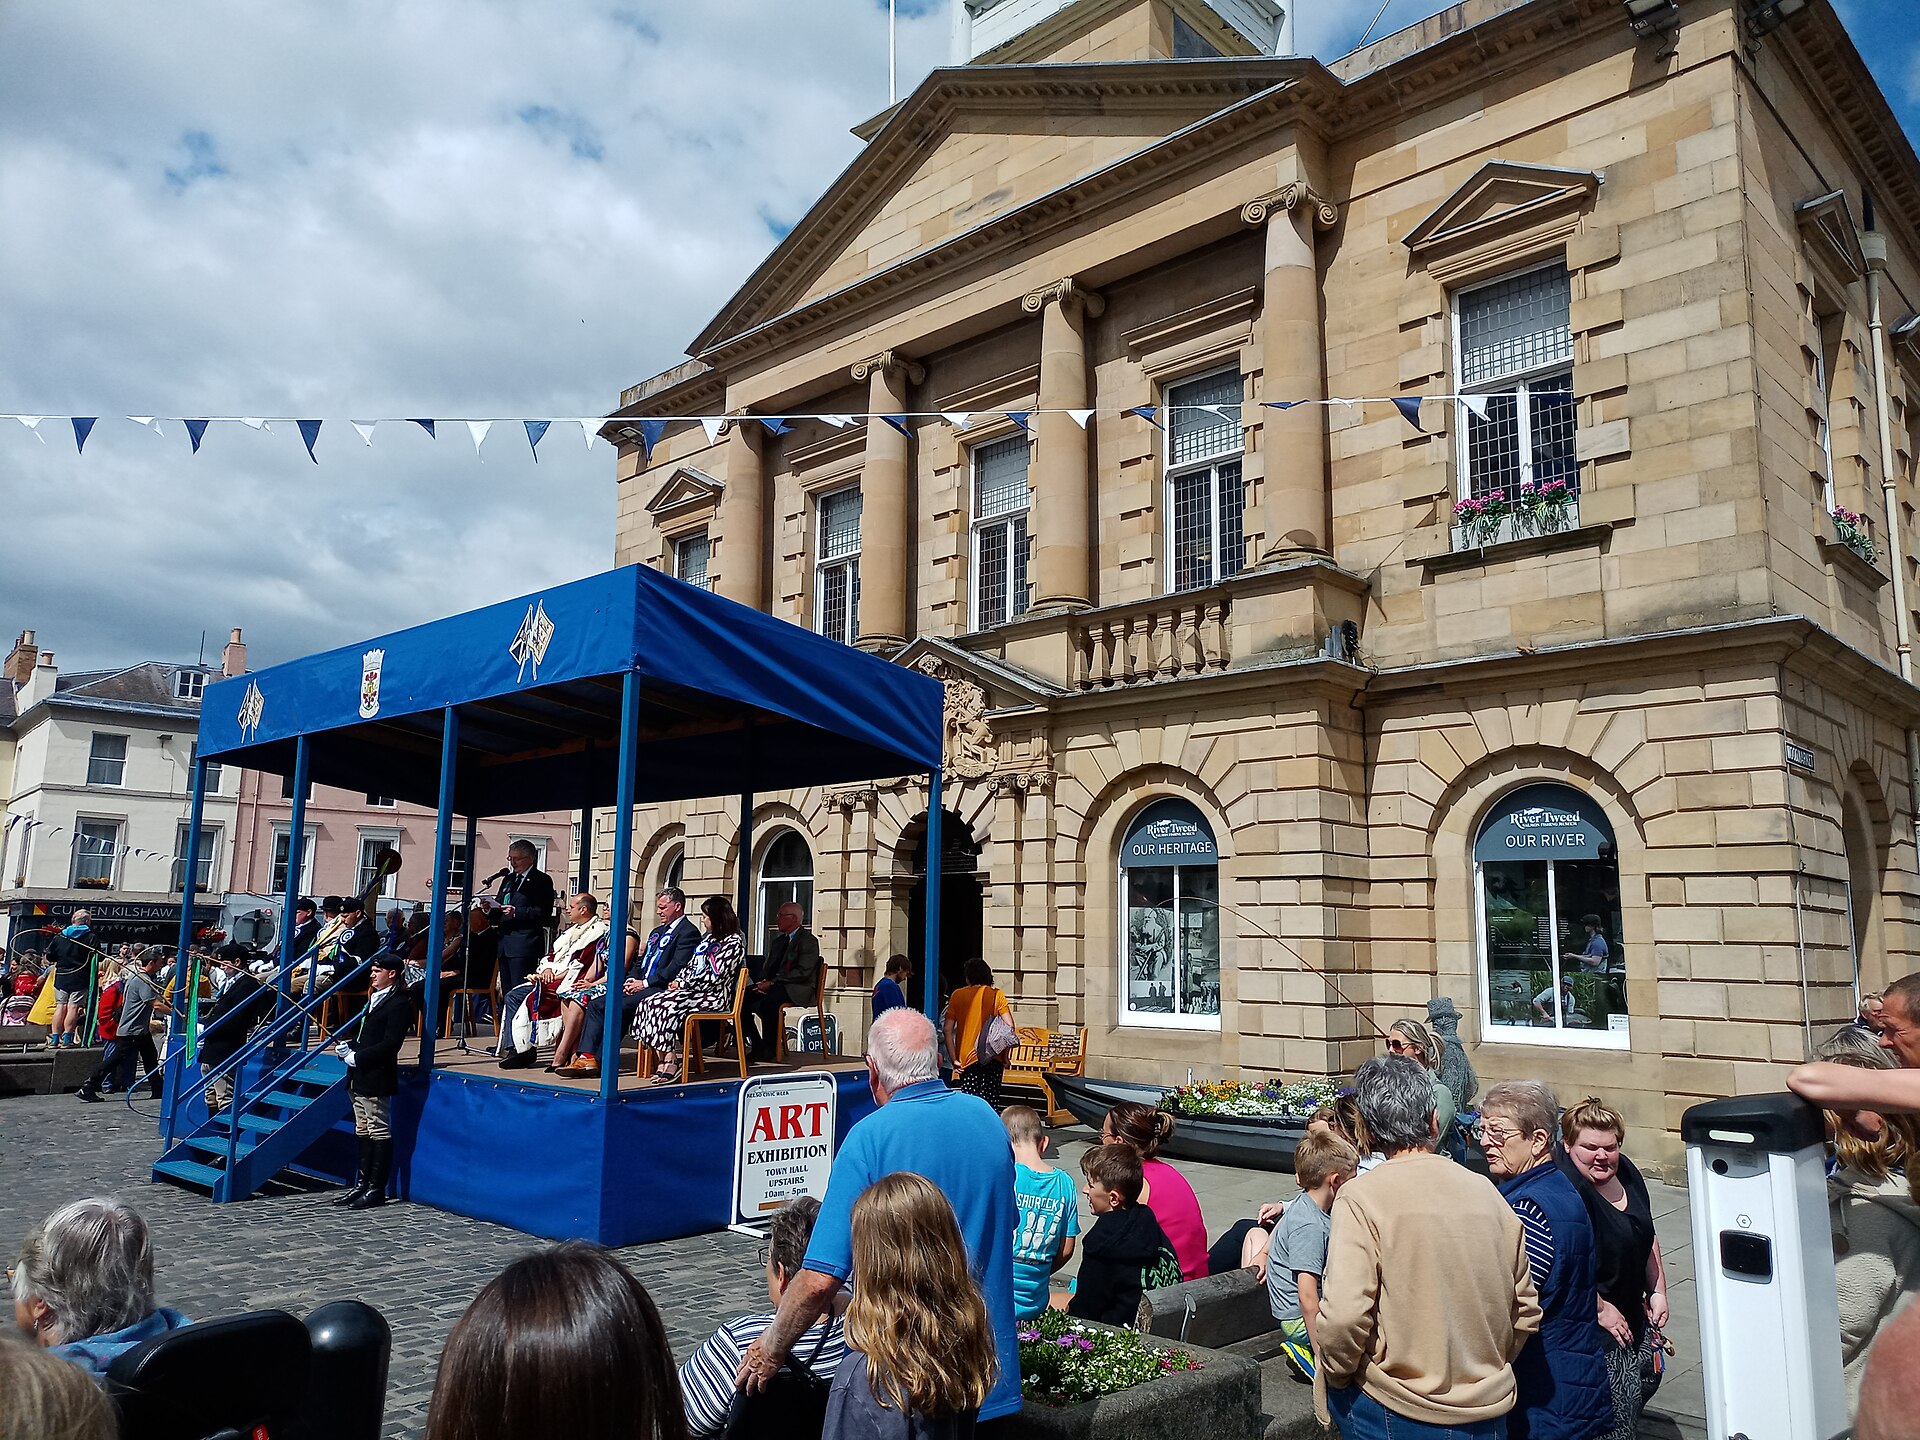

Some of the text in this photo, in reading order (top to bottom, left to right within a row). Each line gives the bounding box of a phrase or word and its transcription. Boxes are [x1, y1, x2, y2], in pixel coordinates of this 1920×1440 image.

[1510, 811, 1581, 830] River Tweed
[1146, 822, 1198, 839] River Tweed
[1505, 833, 1586, 848] OUR RIVER
[1133, 842, 1212, 856] OUR HERITAGE
[51, 905, 109, 916] CULEN
[111, 906, 174, 918] KILSHAW
[747, 1102, 830, 1144] ART
[747, 1143, 828, 1165] EXHIBITION
[765, 1164, 809, 1177] TOWN HALL
[768, 1176, 805, 1188] UPSTAIRS
[764, 1189, 785, 1199] 10am
[791, 1186, 808, 1198] 5pm
